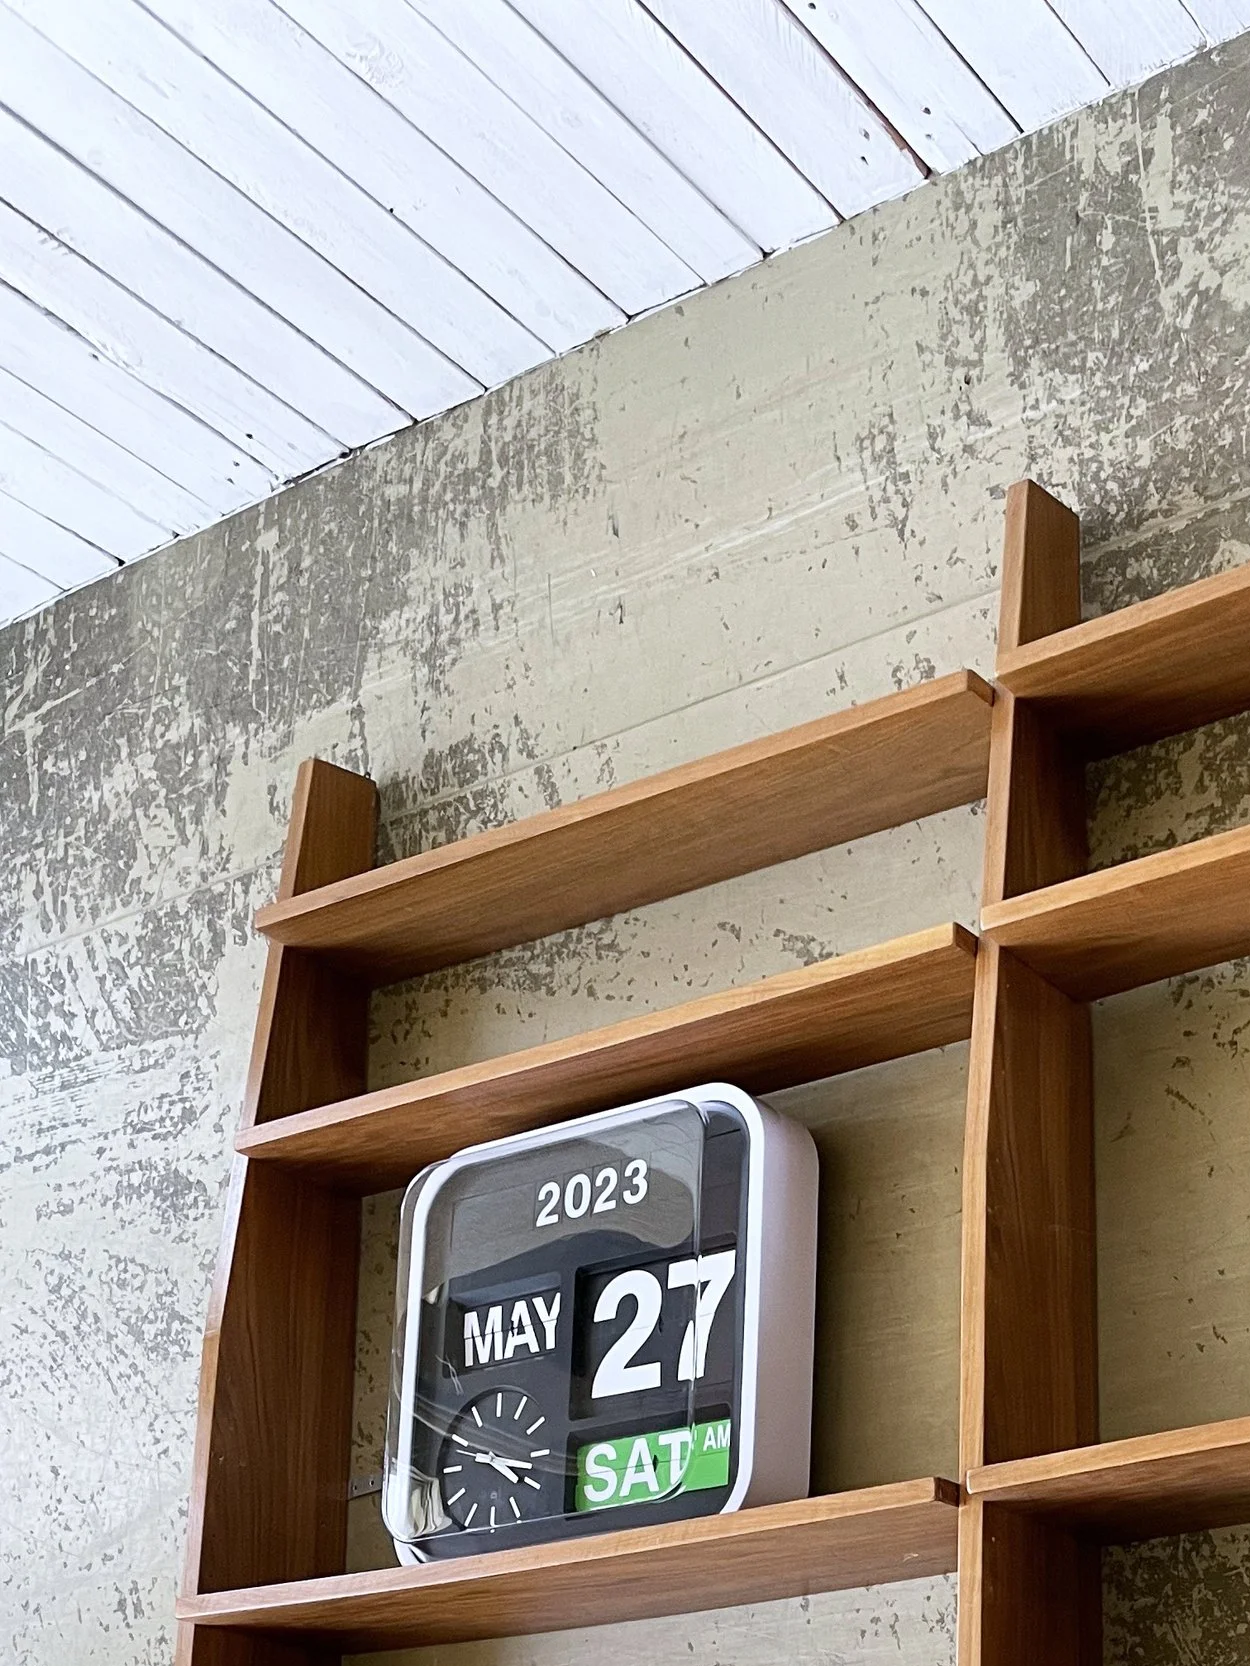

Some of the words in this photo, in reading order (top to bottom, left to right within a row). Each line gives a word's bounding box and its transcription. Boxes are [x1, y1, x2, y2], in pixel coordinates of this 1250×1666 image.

[535, 1158, 648, 1228] 2023
[463, 1291, 562, 1368] MAY
[591, 1249, 737, 1400] 27
[583, 1429, 692, 1502] SAT
[702, 1421, 732, 1451] AM
